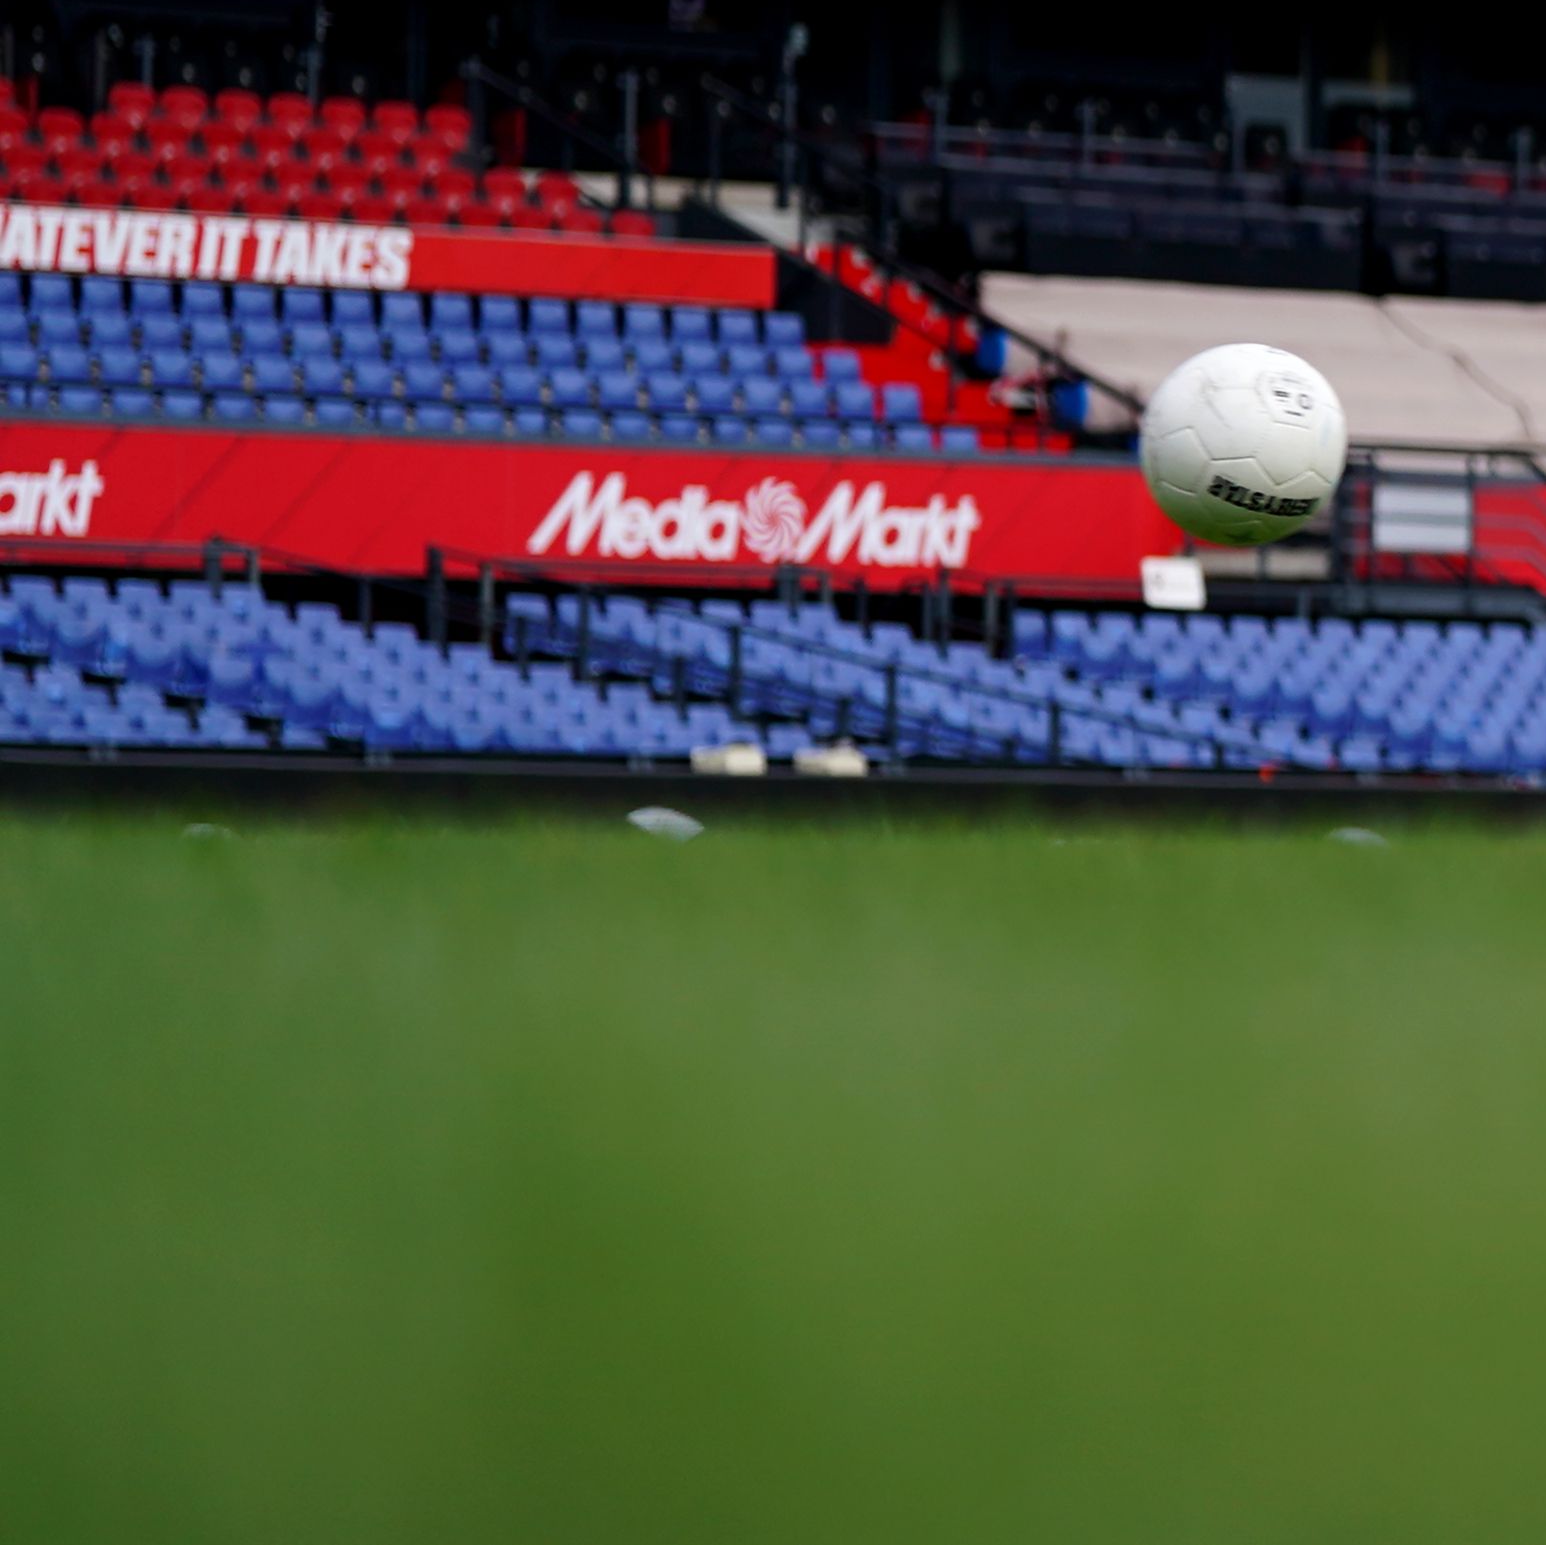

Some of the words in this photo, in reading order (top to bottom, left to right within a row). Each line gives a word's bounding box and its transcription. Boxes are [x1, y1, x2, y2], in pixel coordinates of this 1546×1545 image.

[0, 203, 197, 281] ATEVER
[198, 214, 253, 281] IT
[251, 219, 414, 290] TAKES
[526, 469, 742, 561] Media
[799, 480, 981, 568] Markt
